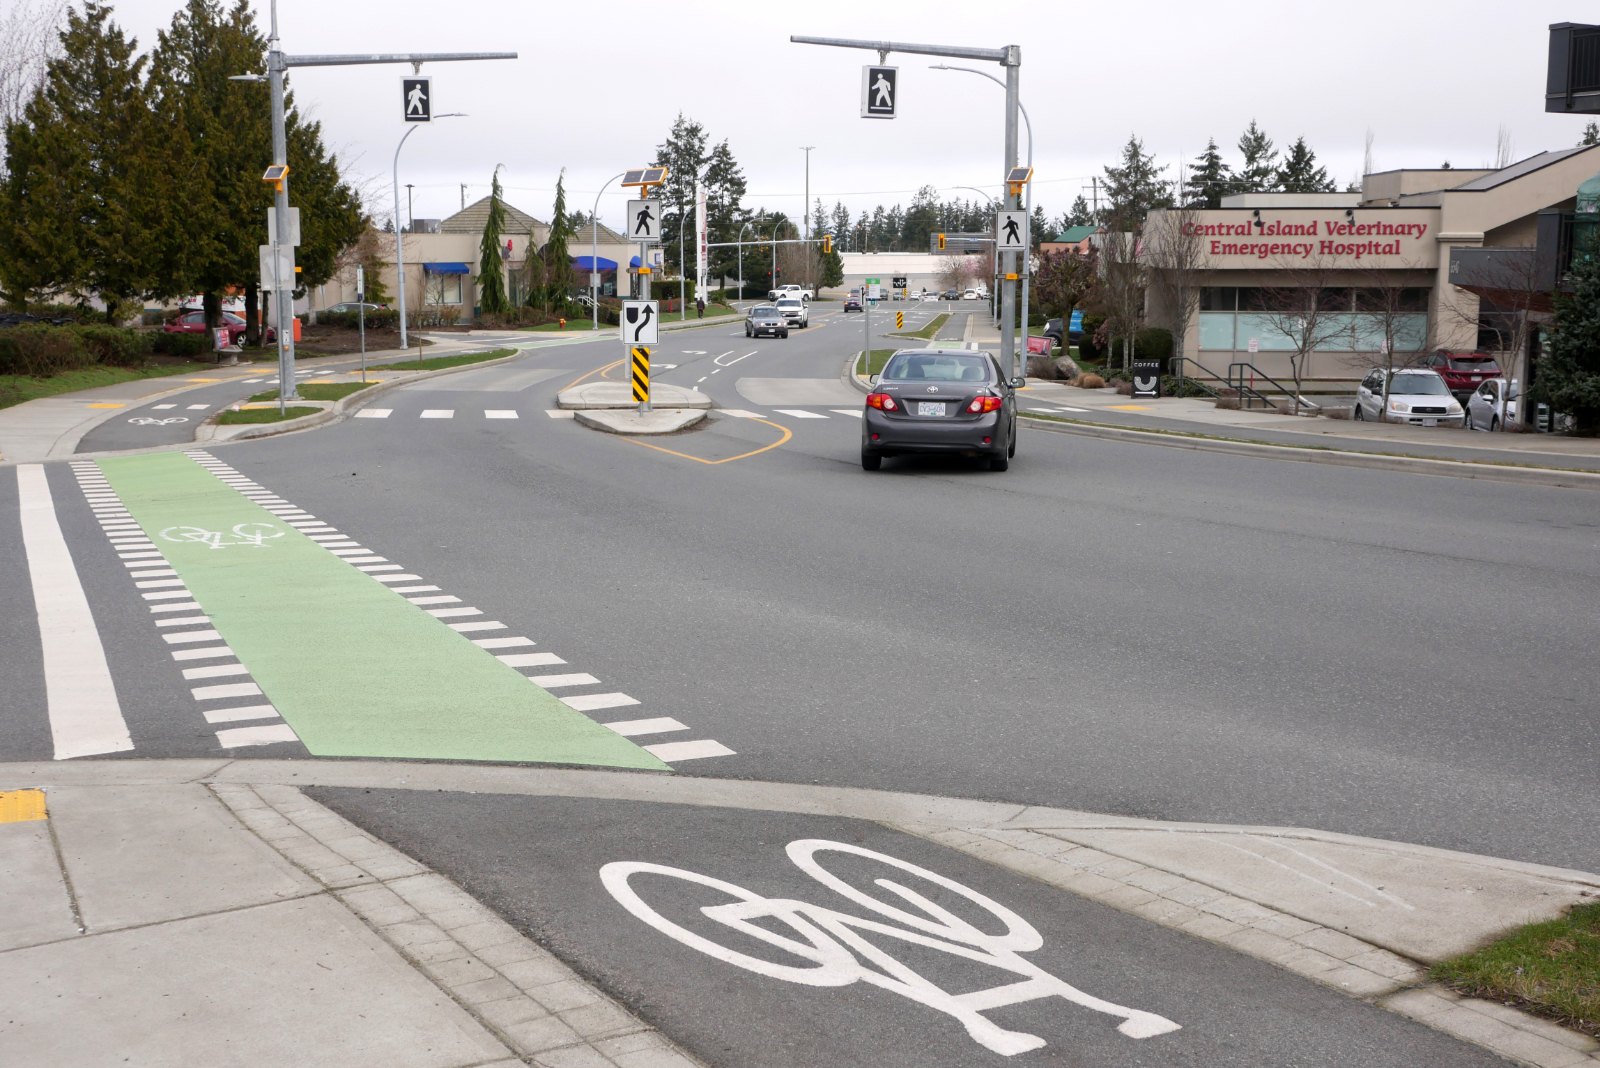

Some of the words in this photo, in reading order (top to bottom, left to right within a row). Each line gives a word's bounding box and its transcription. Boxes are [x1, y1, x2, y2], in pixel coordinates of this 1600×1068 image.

[1182, 220, 1252, 236] Central
[1258, 220, 1318, 236] Island
[1325, 221, 1427, 239] Veterinary
[1210, 240, 1314, 258] Emergency
[1319, 239, 1401, 258] Hospital
